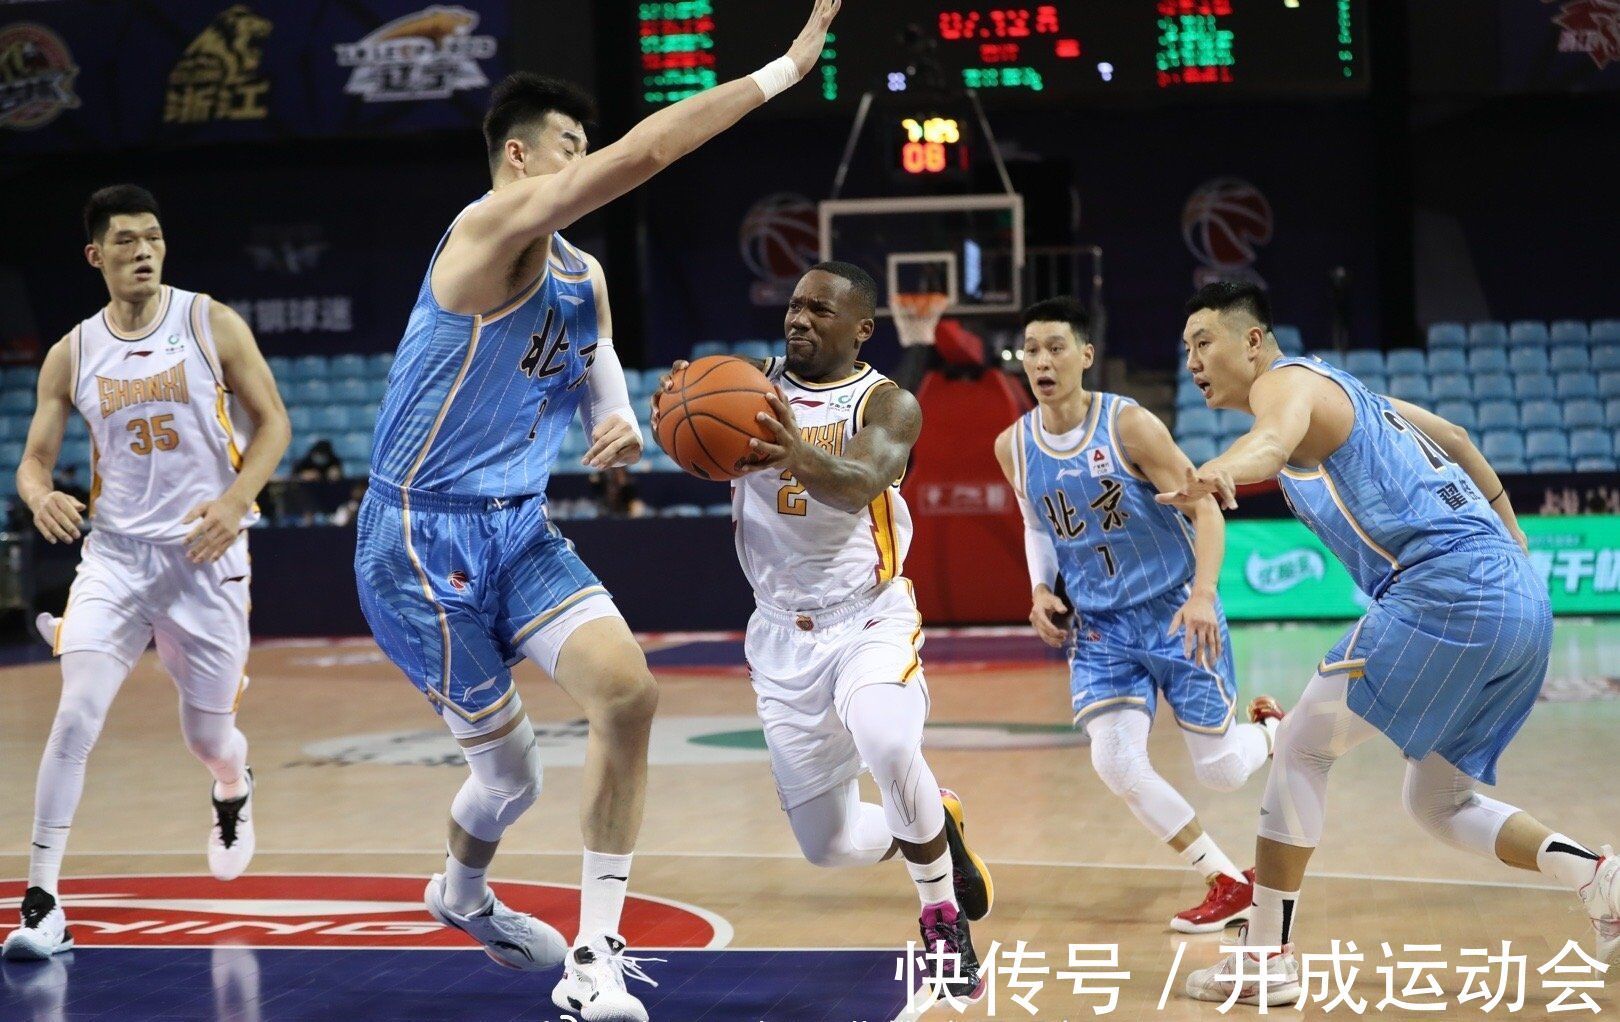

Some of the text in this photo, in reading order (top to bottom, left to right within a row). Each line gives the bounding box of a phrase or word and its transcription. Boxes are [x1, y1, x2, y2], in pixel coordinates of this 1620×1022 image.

[94, 358, 190, 421] SHANXI
[125, 413, 180, 457] 35
[800, 418, 849, 457] NXI
[1043, 478, 1130, 541] 北京
